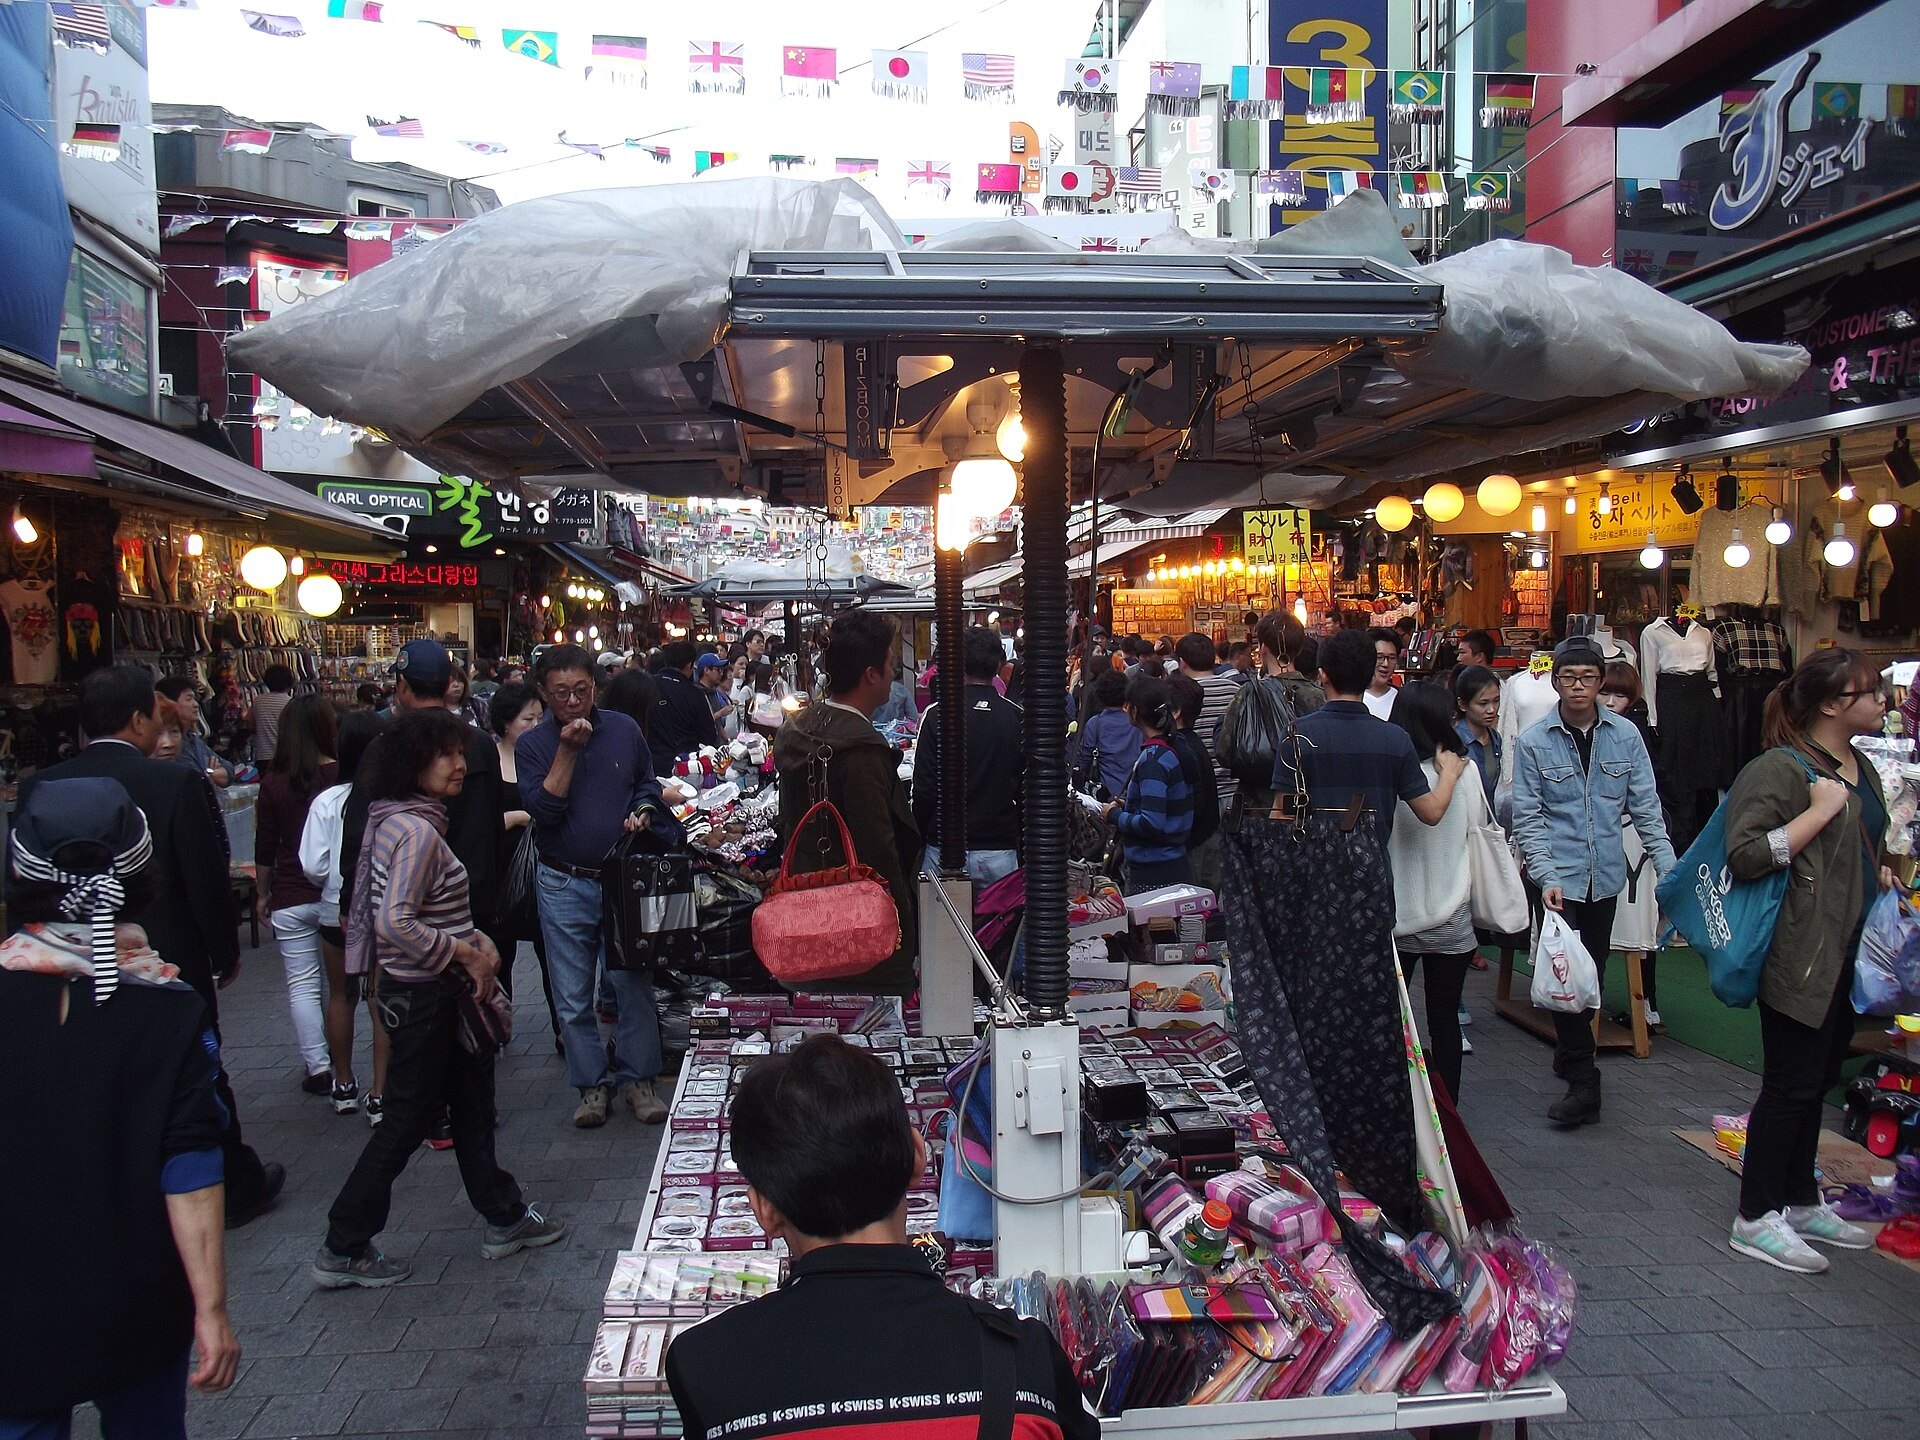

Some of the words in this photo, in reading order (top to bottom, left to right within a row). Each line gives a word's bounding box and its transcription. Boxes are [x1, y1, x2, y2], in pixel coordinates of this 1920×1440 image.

[1079, 130, 1111, 152] 대도
[1829, 356, 1848, 392] &
[327, 491, 364, 507] KARL
[368, 493, 425, 509] OPTICAL
[1611, 492, 1641, 506] Belt
[1631, 502, 1672, 523] ベルト
